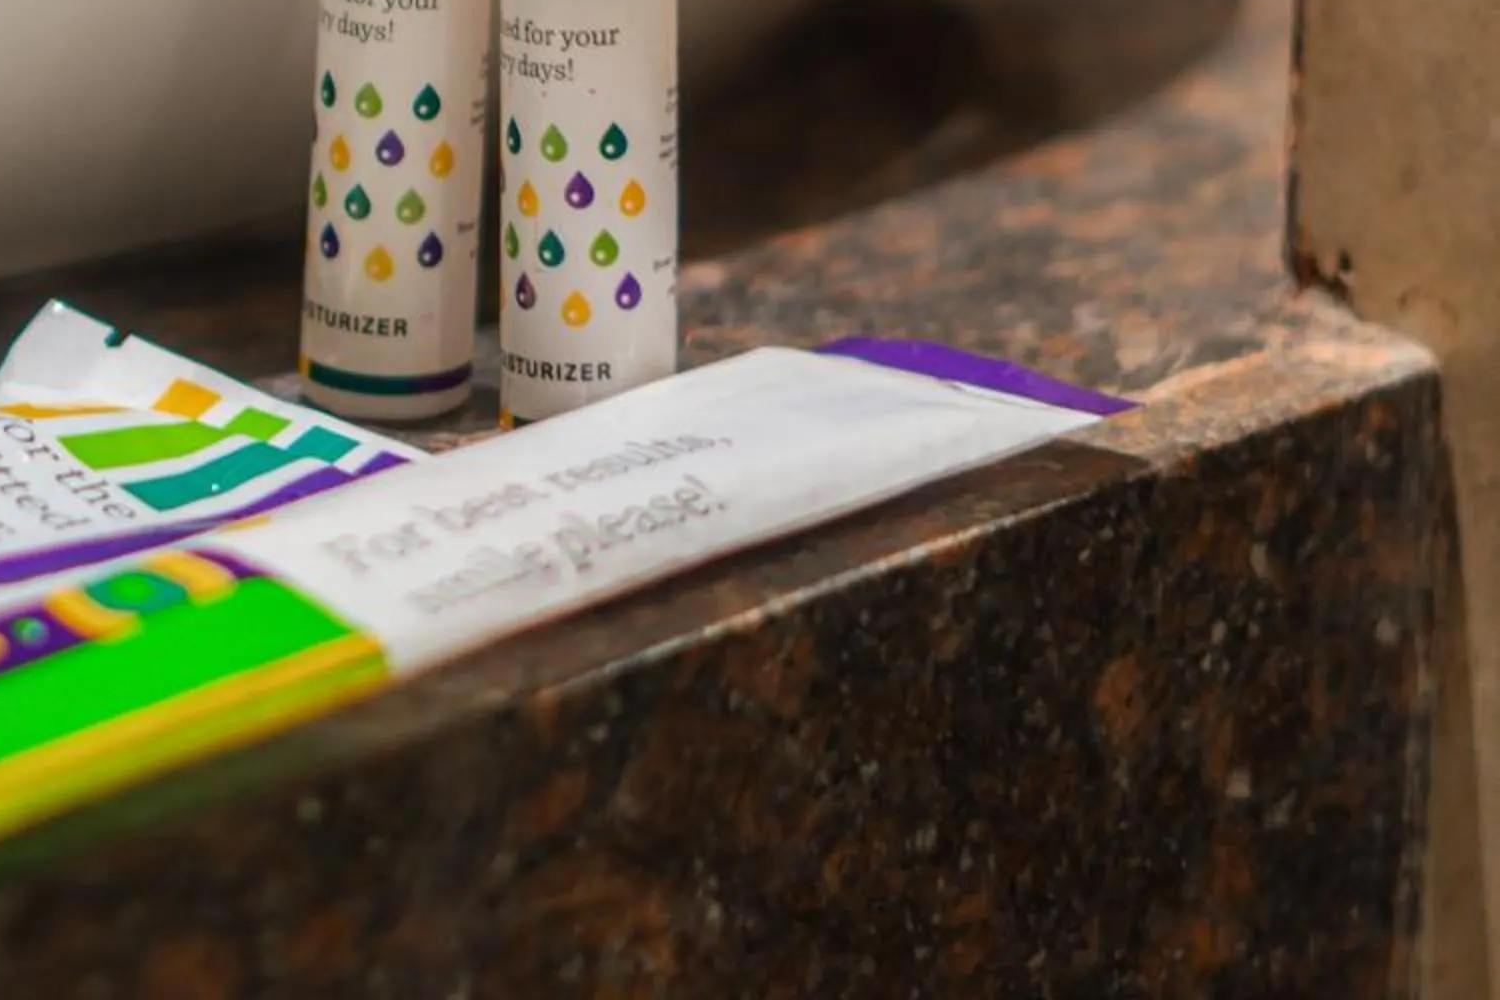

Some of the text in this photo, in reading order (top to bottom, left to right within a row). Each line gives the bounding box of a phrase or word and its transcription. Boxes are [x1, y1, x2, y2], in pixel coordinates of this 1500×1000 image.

[336, 9, 395, 44] days!
[524, 19, 556, 47] for
[559, 27, 621, 52] your
[517, 53, 575, 85] days!
[305, 300, 409, 338] STURIZER
[503, 352, 613, 382] STURIZER
[55, 466, 138, 521] the
[318, 530, 431, 575] For
[410, 482, 550, 532] best
[552, 473, 727, 575] please!
